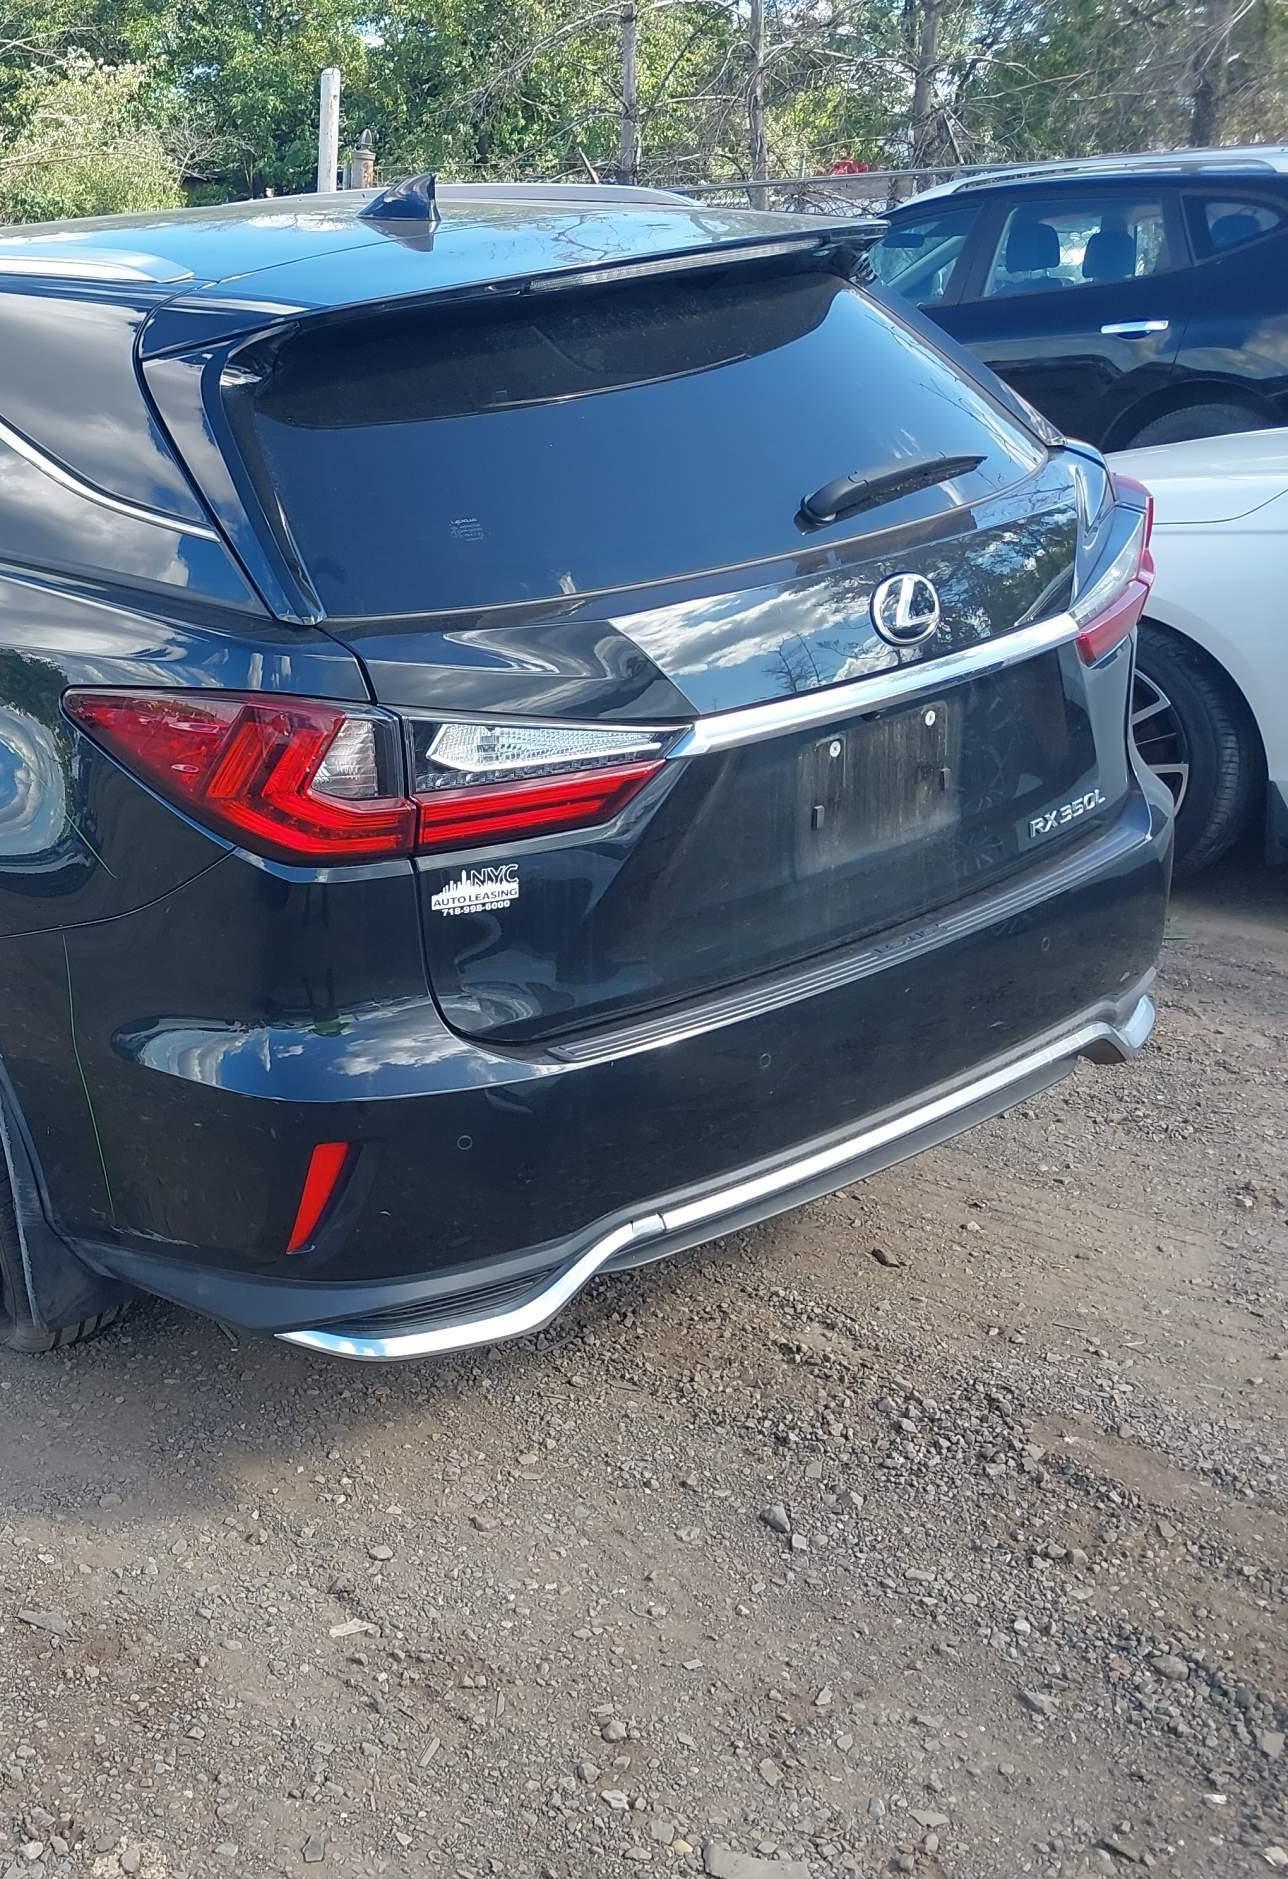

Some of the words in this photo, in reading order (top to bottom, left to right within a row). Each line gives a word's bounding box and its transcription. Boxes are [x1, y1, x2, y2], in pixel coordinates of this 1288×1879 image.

[1028, 810, 1058, 838] RX
[1059, 788, 1106, 824] 350L
[470, 863, 519, 887] NYC
[433, 895, 467, 908] AUTO
[469, 888, 518, 902] LEASING
